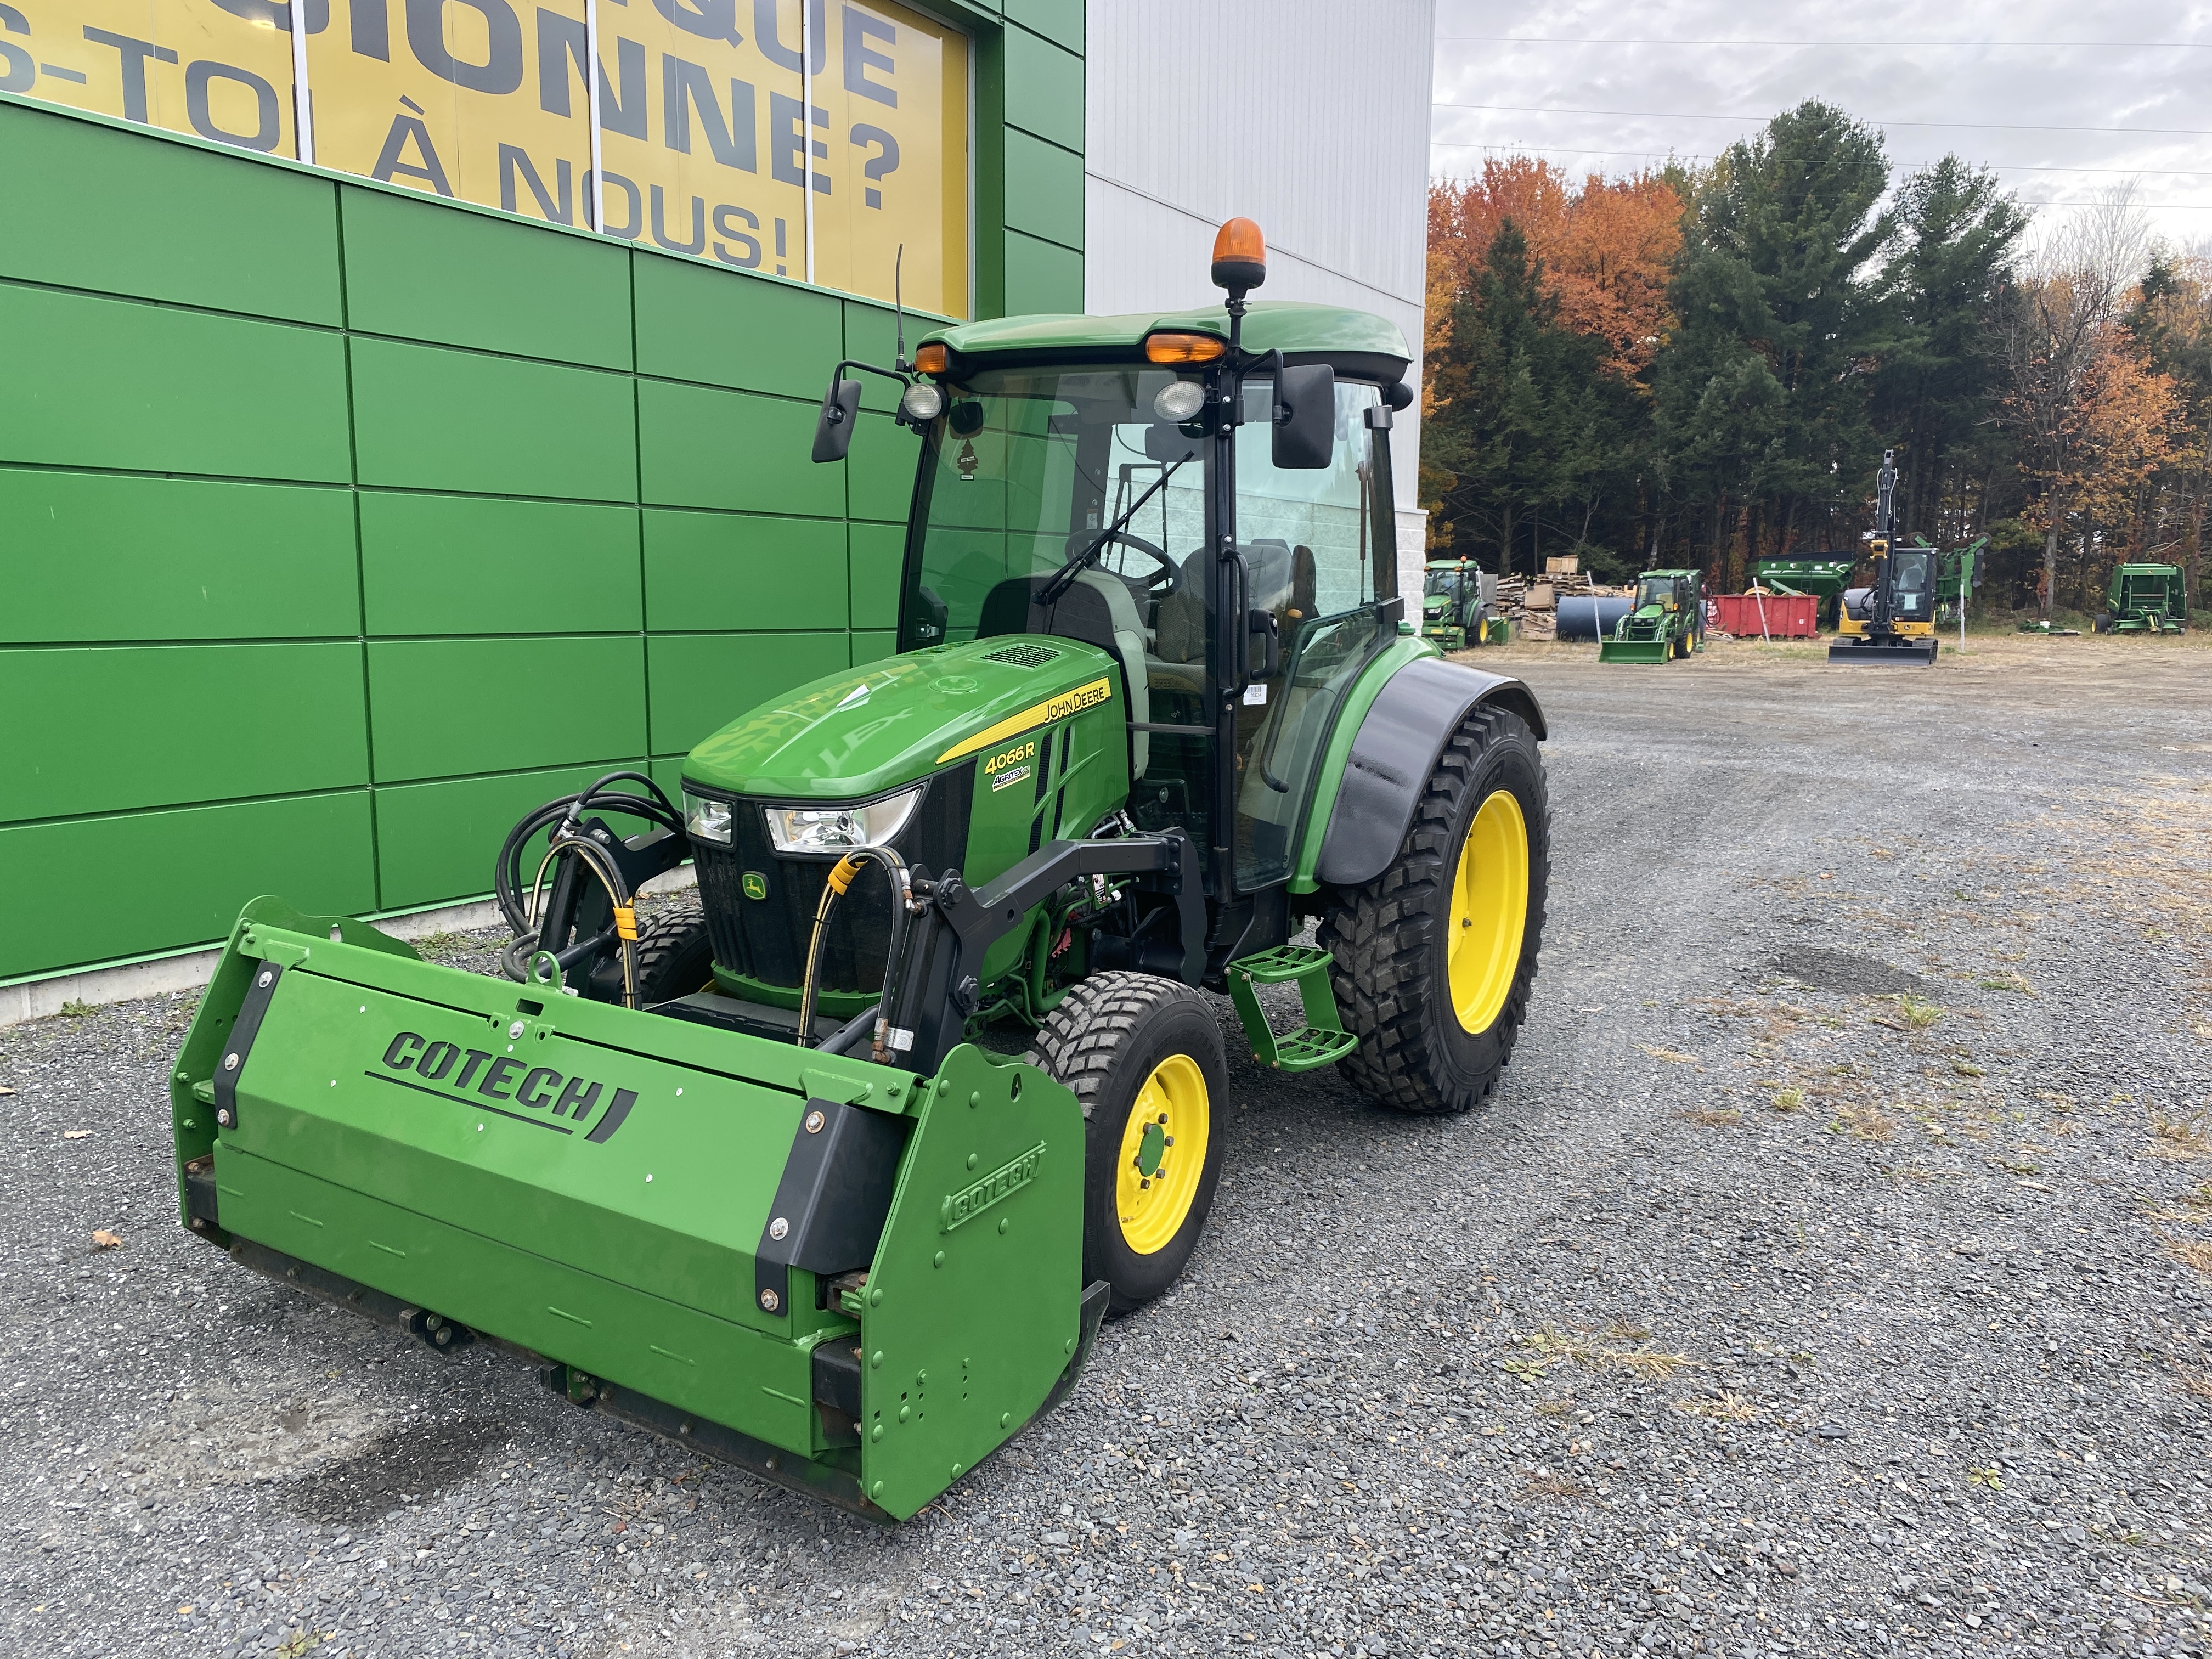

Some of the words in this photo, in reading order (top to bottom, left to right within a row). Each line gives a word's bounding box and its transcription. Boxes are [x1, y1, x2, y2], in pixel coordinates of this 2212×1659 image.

[371, 94, 454, 198] À
[498, 142, 786, 275] NOUS!
[1044, 698, 1073, 721] JOHN
[1074, 687, 1105, 709] DEERE
[382, 1032, 603, 1121] COTECH
[953, 1154, 1036, 1220] COTECH
